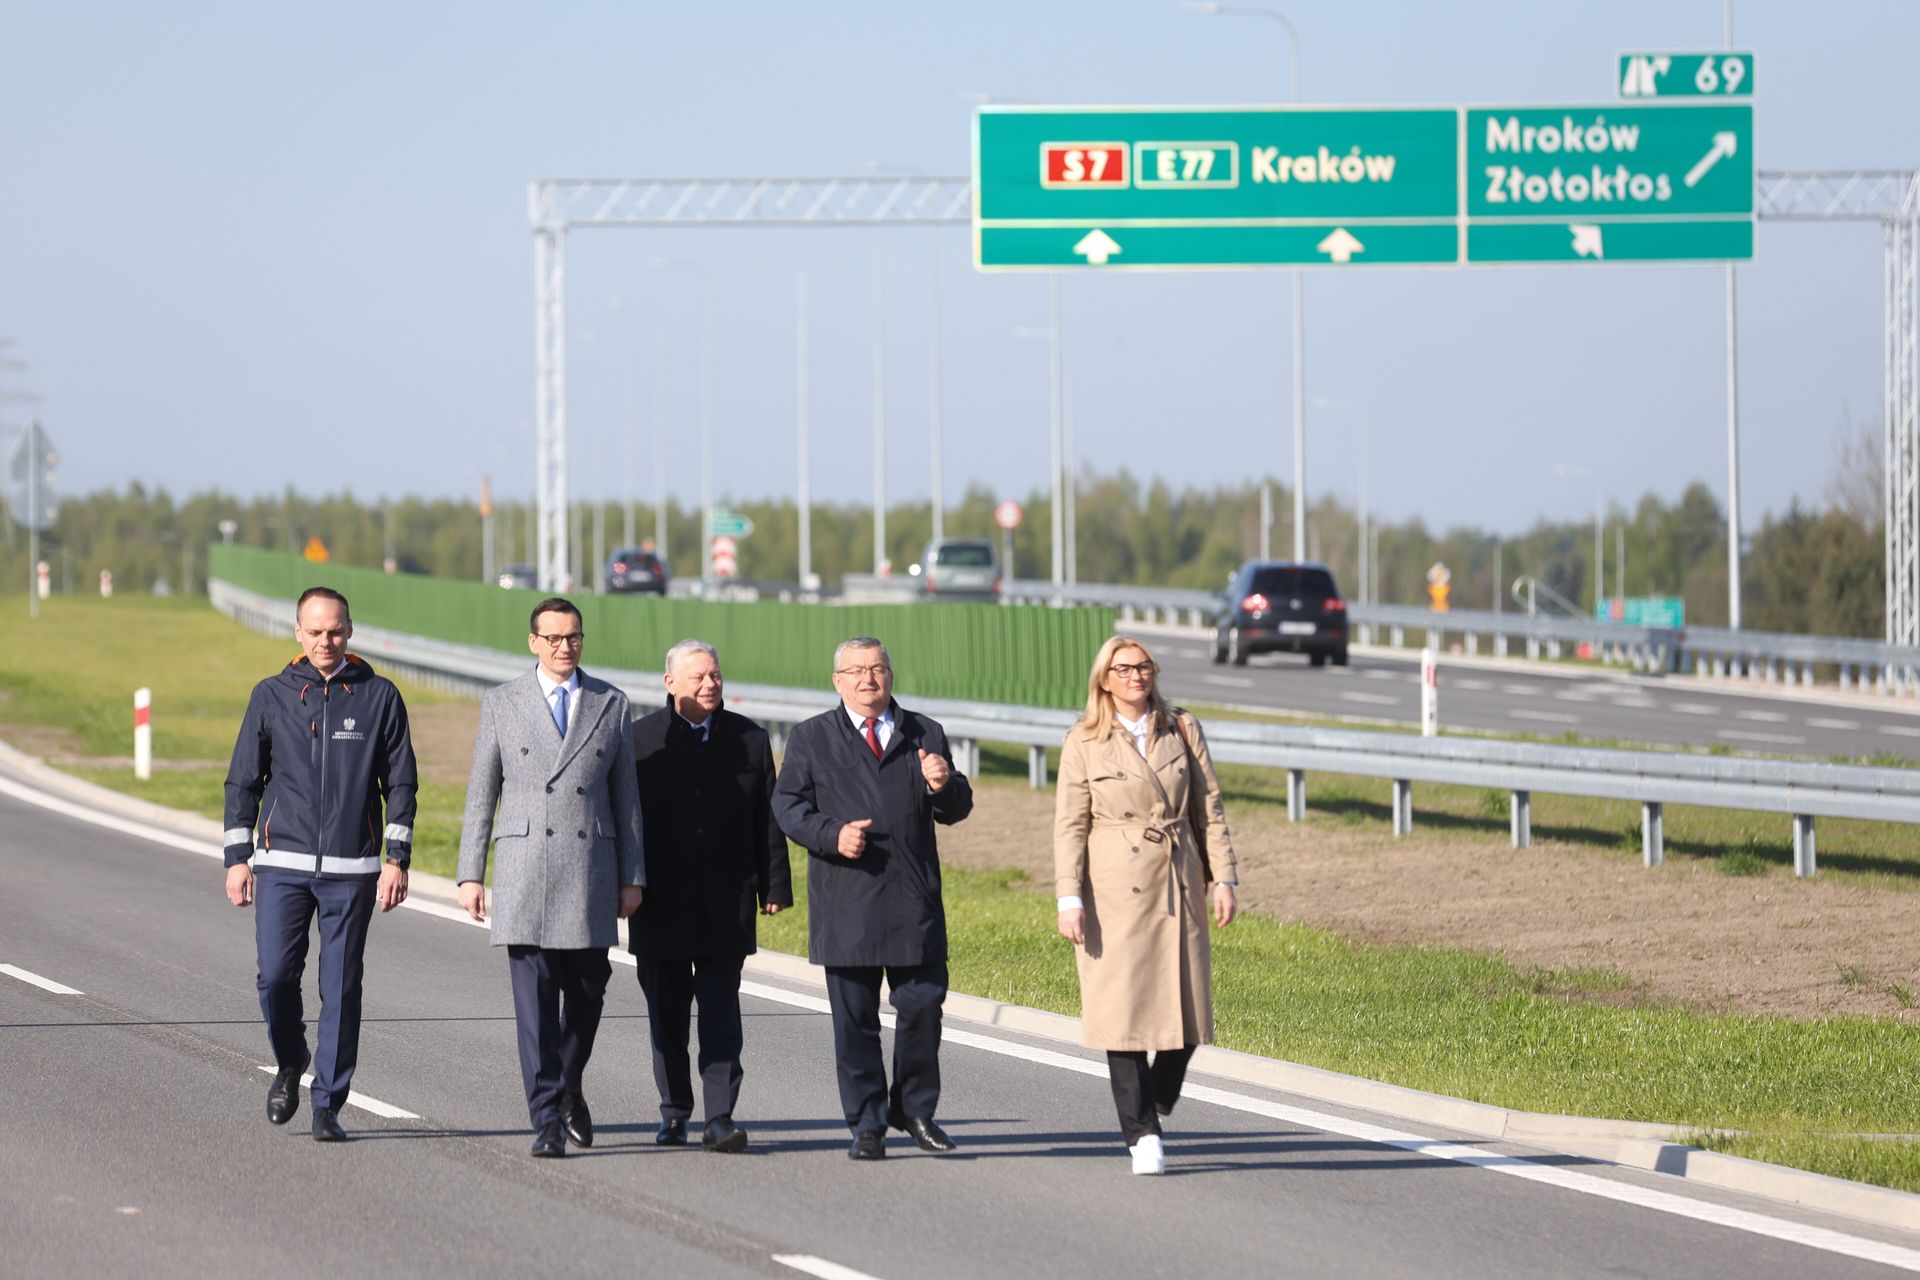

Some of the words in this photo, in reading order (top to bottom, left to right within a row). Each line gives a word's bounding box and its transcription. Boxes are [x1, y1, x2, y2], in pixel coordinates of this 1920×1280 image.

[1695, 56, 1745, 94] 69
[1486, 115, 1640, 153] Mroków
[1252, 145, 1396, 183] Kraków
[1485, 164, 1672, 203] Złotokłos
